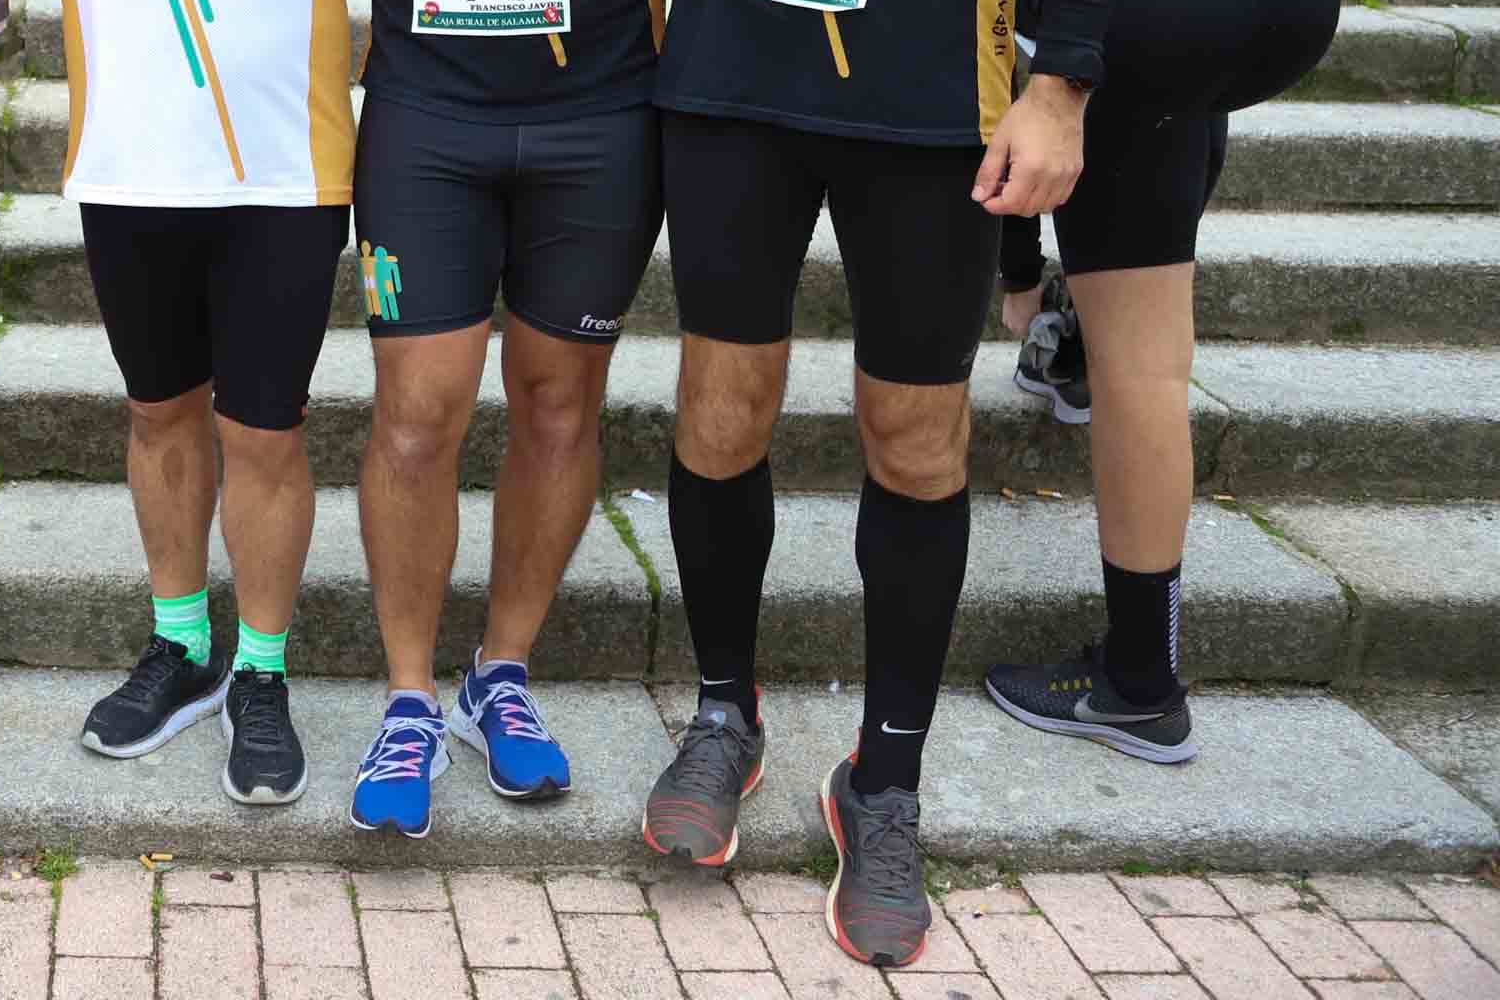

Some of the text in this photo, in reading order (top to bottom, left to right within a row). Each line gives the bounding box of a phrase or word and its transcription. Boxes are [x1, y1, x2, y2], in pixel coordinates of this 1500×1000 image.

[470, 1, 564, 12] FRANCISCO JAVIER
[434, 16, 455, 26] CAJA
[456, 17, 485, 26] RURAL
[487, 17, 500, 26] DE
